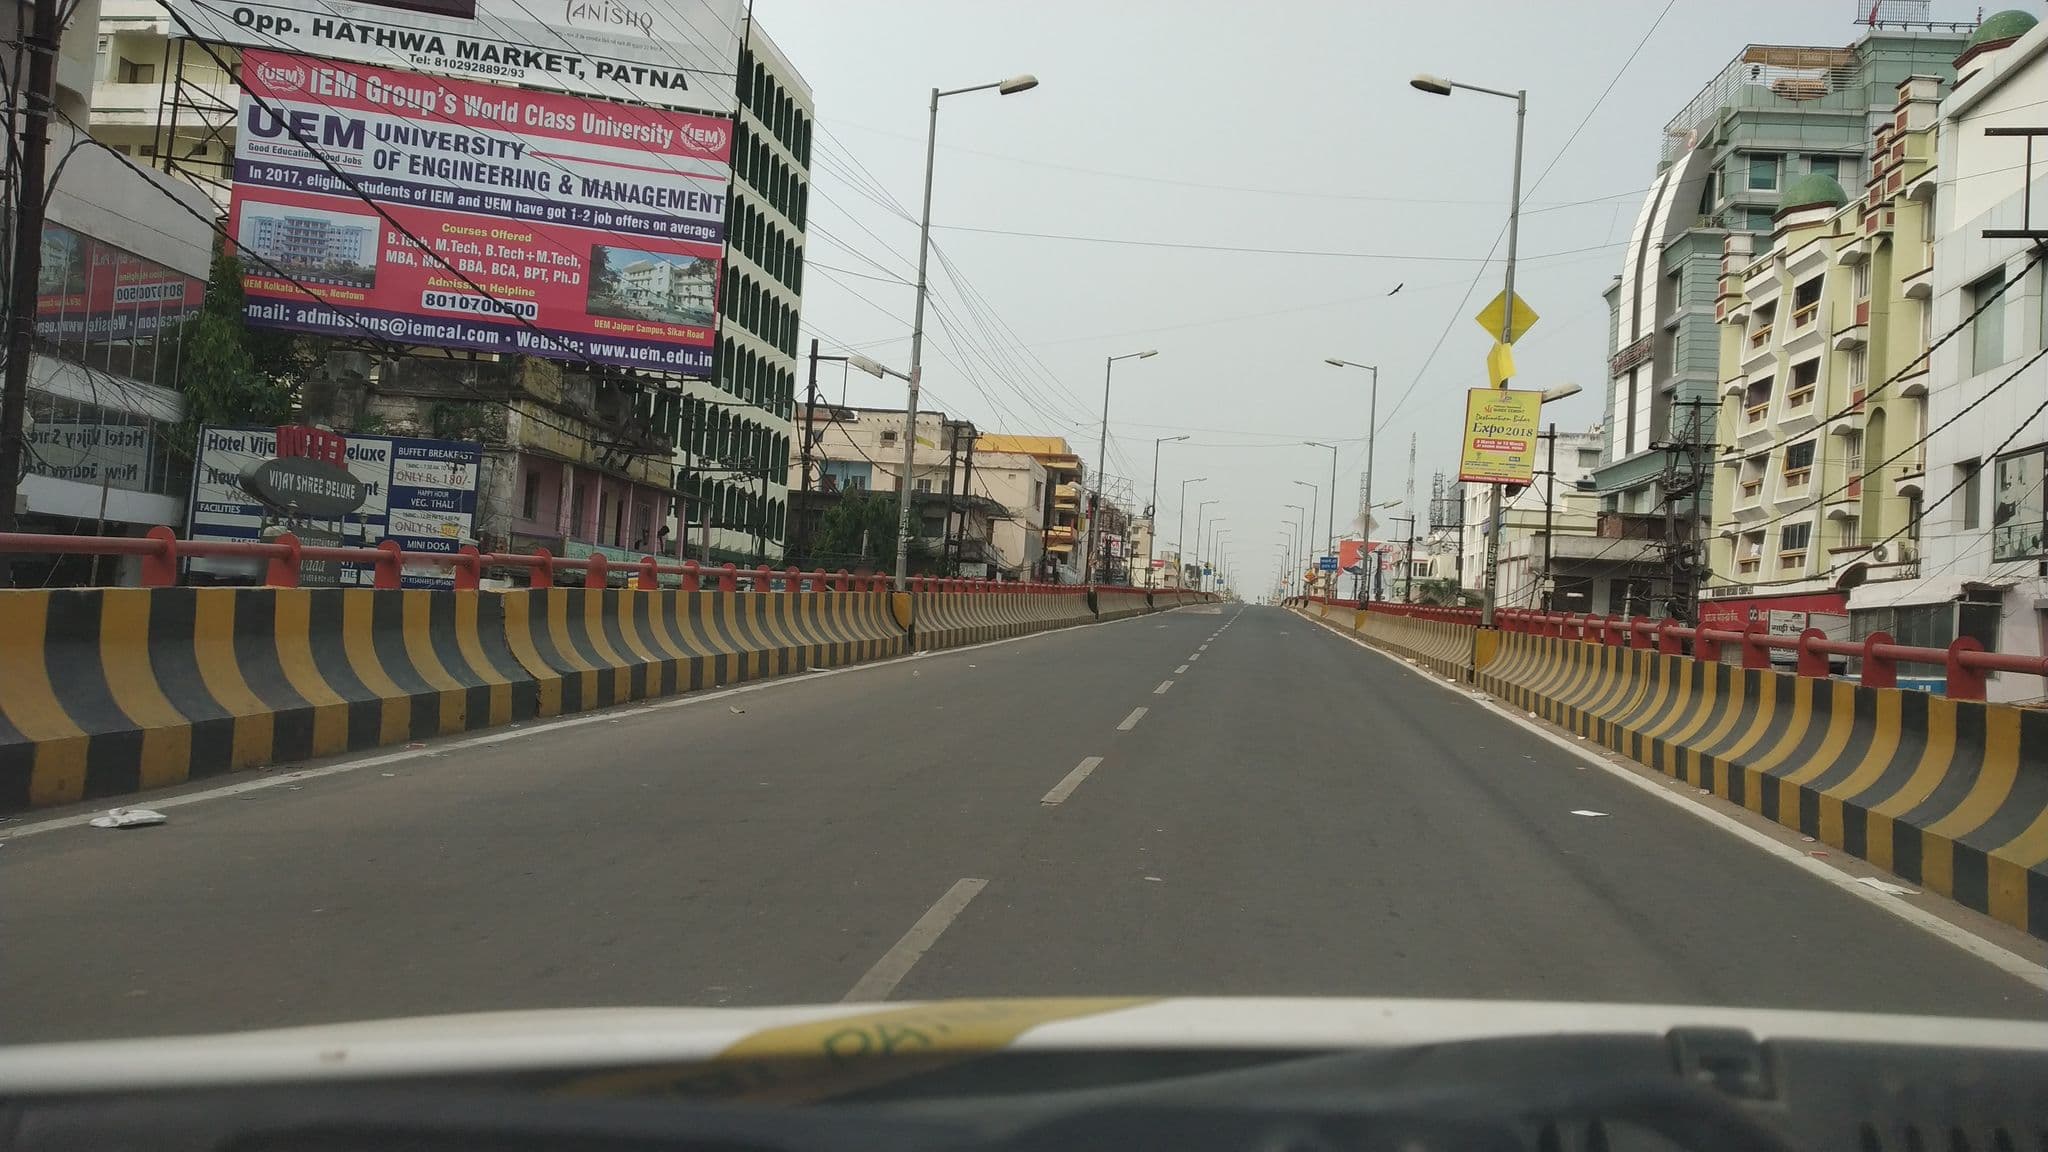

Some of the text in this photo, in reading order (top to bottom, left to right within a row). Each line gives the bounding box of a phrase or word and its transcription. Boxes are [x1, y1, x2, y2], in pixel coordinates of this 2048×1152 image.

[232, 7, 300, 35] Opp.
[312, 17, 446, 55] HATHWA
[456, 40, 586, 80] MARKET,
[596, 61, 689, 91] PATNA
[265, 67, 299, 83] UEM
[409, 53, 525, 79] Tel: 8102928892/93
[310, 67, 674, 149] IEM Group's World Class University
[247, 104, 366, 150] UEM
[688, 127, 719, 145] IEM
[375, 122, 526, 161] UNIVERSITY
[248, 142, 270, 154] Good
[319, 151, 340, 163] Good
[342, 154, 362, 166] Jobs
[373, 149, 725, 215] OF ENGINEERING & MANAGEMENT
[249, 165, 716, 239] In 2017, eligible students of IEM and UEM have got 1-2 job offers on average
[441, 223, 532, 243] Courses Offered
[435, 238, 482, 257] M.Tech,
[485, 244, 582, 270] B.Tech+M.Tech,
[385, 250, 418, 267] MBA,
[458, 258, 487, 275] BBA,
[491, 262, 520, 280] BCA,
[523, 266, 550, 284] BPT,
[553, 271, 581, 285] Ph.D
[243, 278, 262, 289] UEM
[263, 281, 294, 293] Kolkata
[330, 288, 365, 301] Newtown
[427, 276, 536, 299] Admission Helpline
[425, 293, 536, 317] 8010700500
[242, 302, 713, 368] -mail: admissions@iemcal.com Website: www.uem.edu.in
[594, 319, 705, 340] UEM Jaipur Campus, Sikar Road
[1473, 422, 1534, 437] Expo 2018
[207, 433, 386, 462] Hotel Vija eluxe
[398, 447, 427, 457] BUFFET
[269, 469, 295, 491] VIJAY
[296, 474, 324, 495] SHREE
[325, 479, 356, 500] DELUXE
[396, 470, 424, 483] ONLY
[426, 473, 440, 484] Rs.
[200, 503, 241, 514] FACILITIES
[410, 497, 455, 509] VEG. THALI
[395, 521, 423, 533] ONLY
[425, 523, 440, 534] Rs.
[407, 539, 450, 551] MINI DOSA
